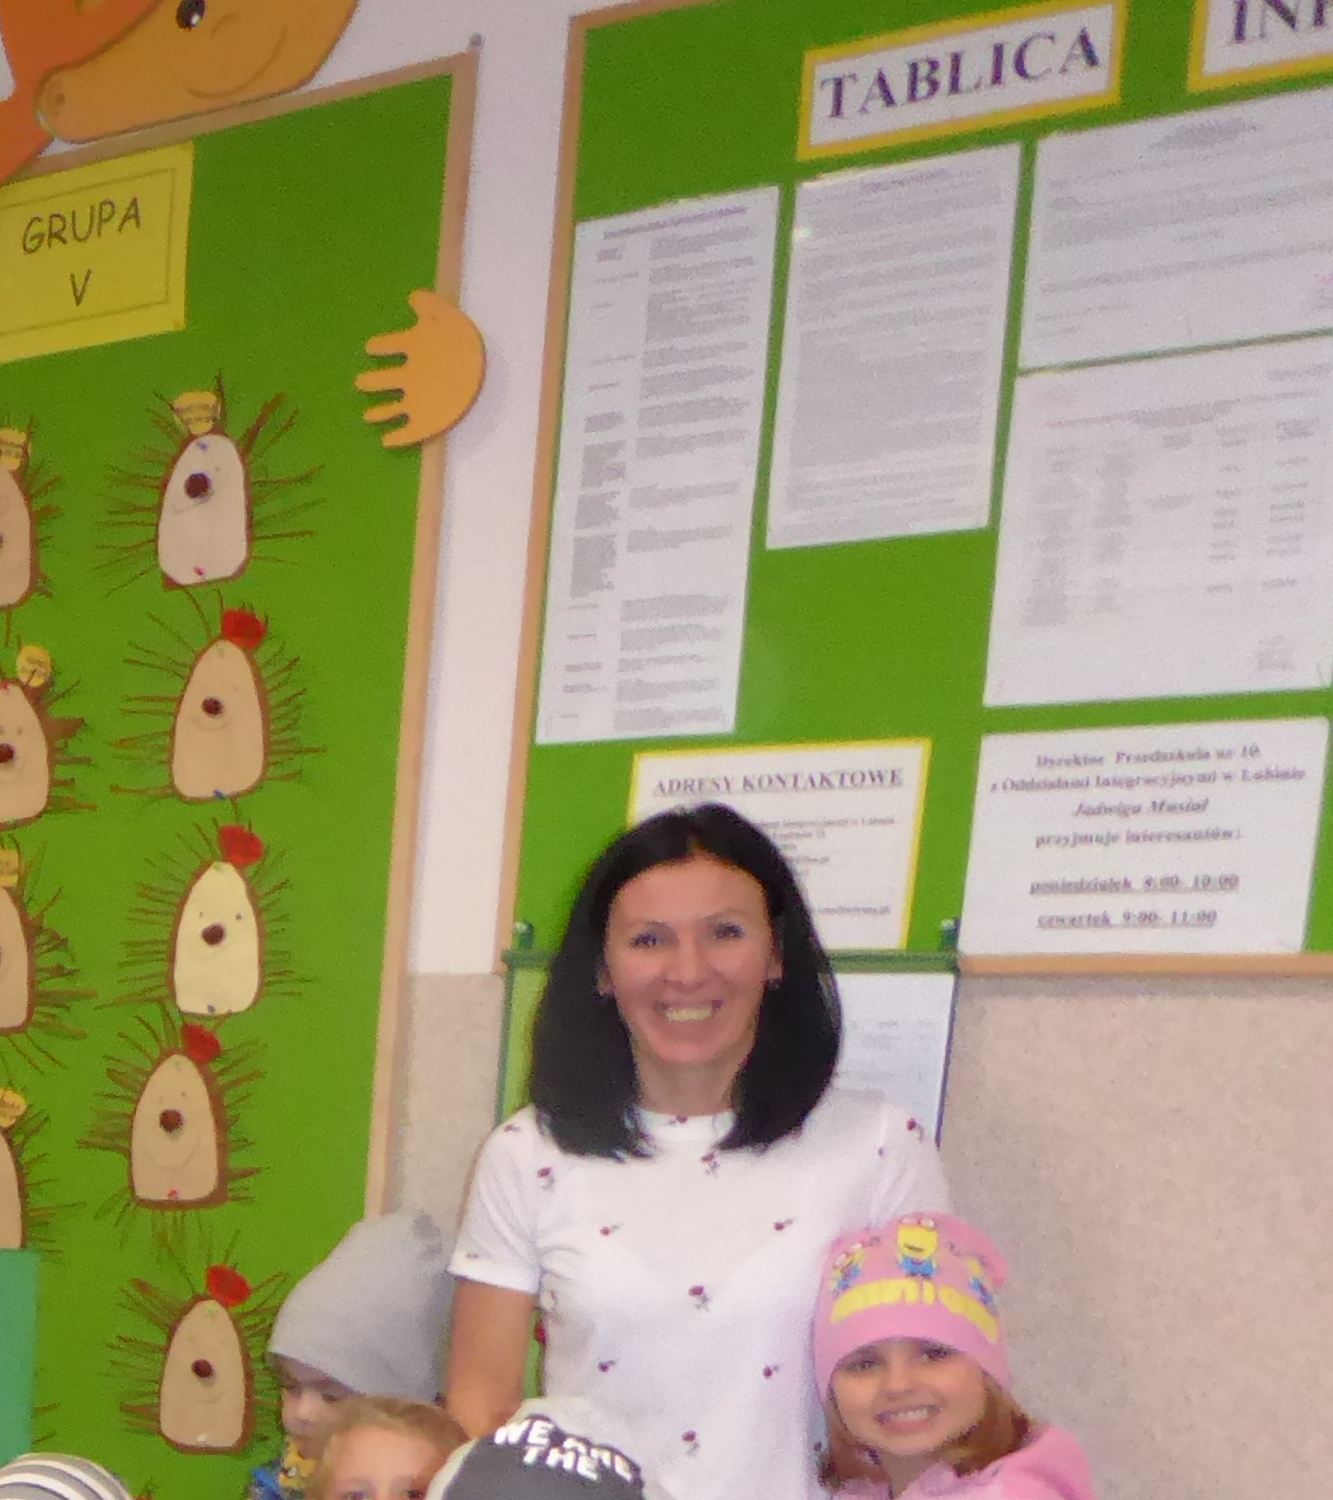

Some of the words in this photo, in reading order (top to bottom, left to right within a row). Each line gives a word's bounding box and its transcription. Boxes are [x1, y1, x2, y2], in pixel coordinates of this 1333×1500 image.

[819, 27, 1101, 118] TABLICA
[22, 197, 141, 256] GRUPA
[70, 269, 93, 307] V
[1036, 753, 1104, 769] Dyrektor
[655, 775, 734, 796] ADRESY
[741, 768, 903, 791] KONTAKTOWE
[1035, 830, 1120, 848] przyjmuje
[494, 1420, 556, 1446] WE
[523, 1446, 599, 1481] THE
